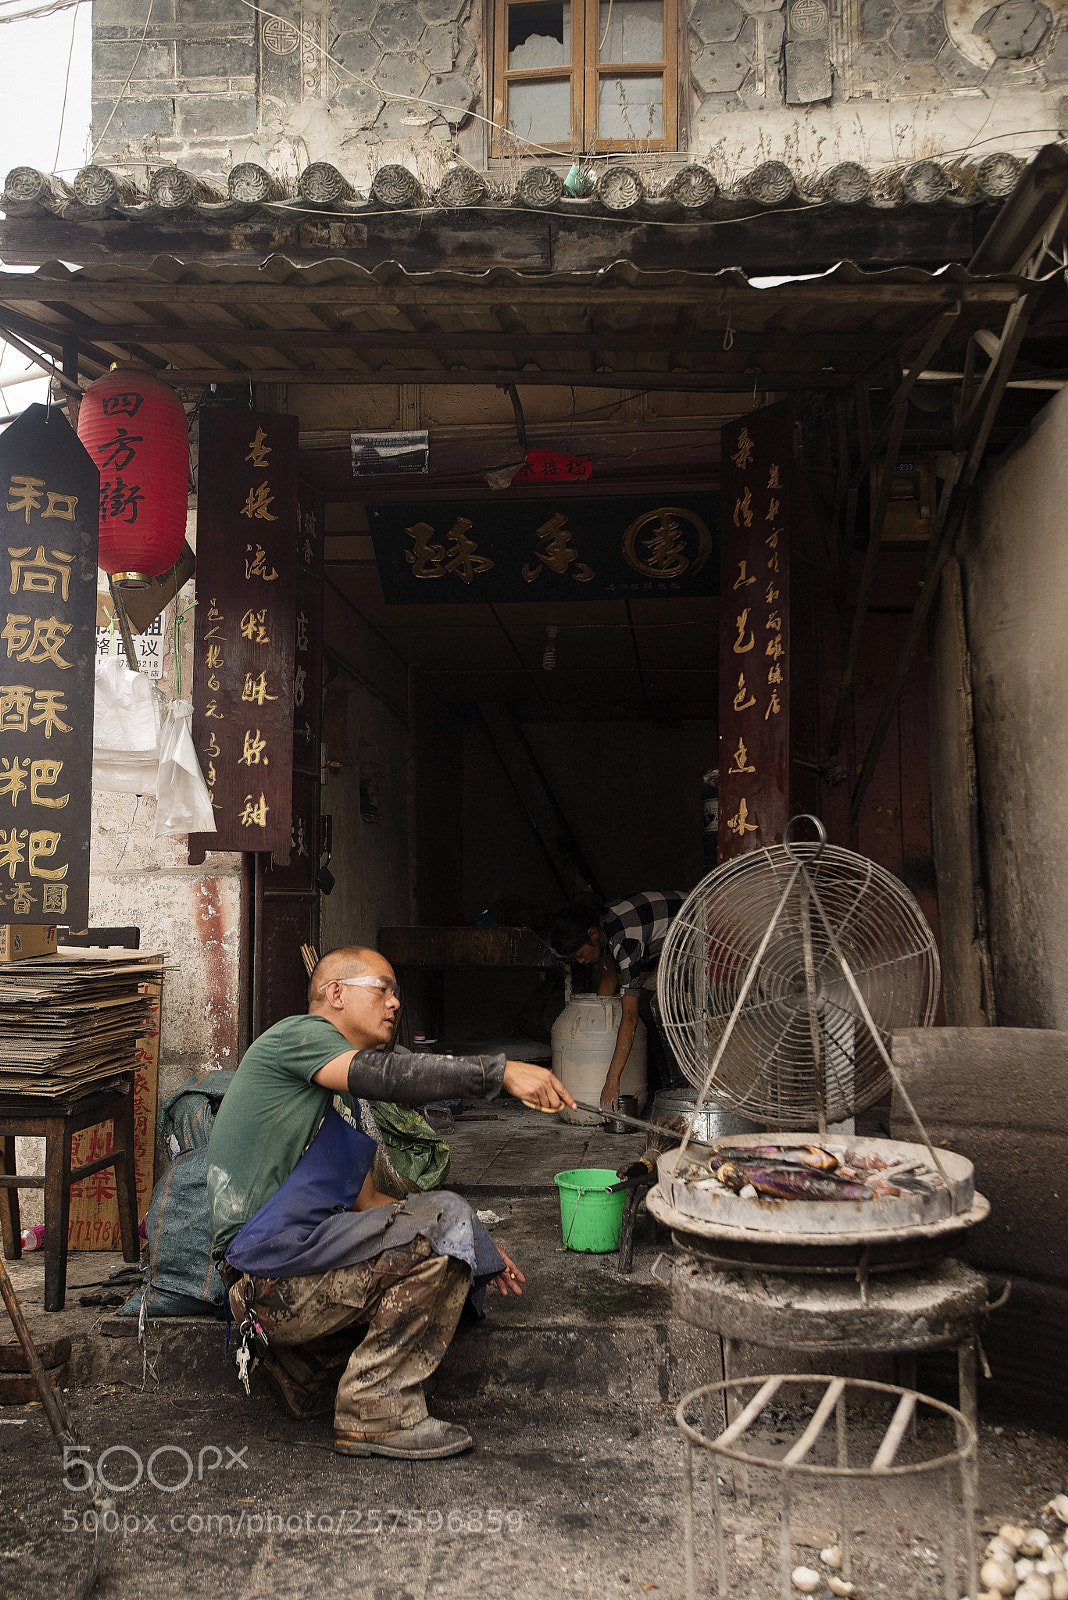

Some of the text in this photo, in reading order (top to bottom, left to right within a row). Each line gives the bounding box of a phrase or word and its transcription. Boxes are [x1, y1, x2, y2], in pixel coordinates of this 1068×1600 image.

[98, 392, 145, 524] 四方街
[0, 474, 79, 881] 和尚破酥粑粑
